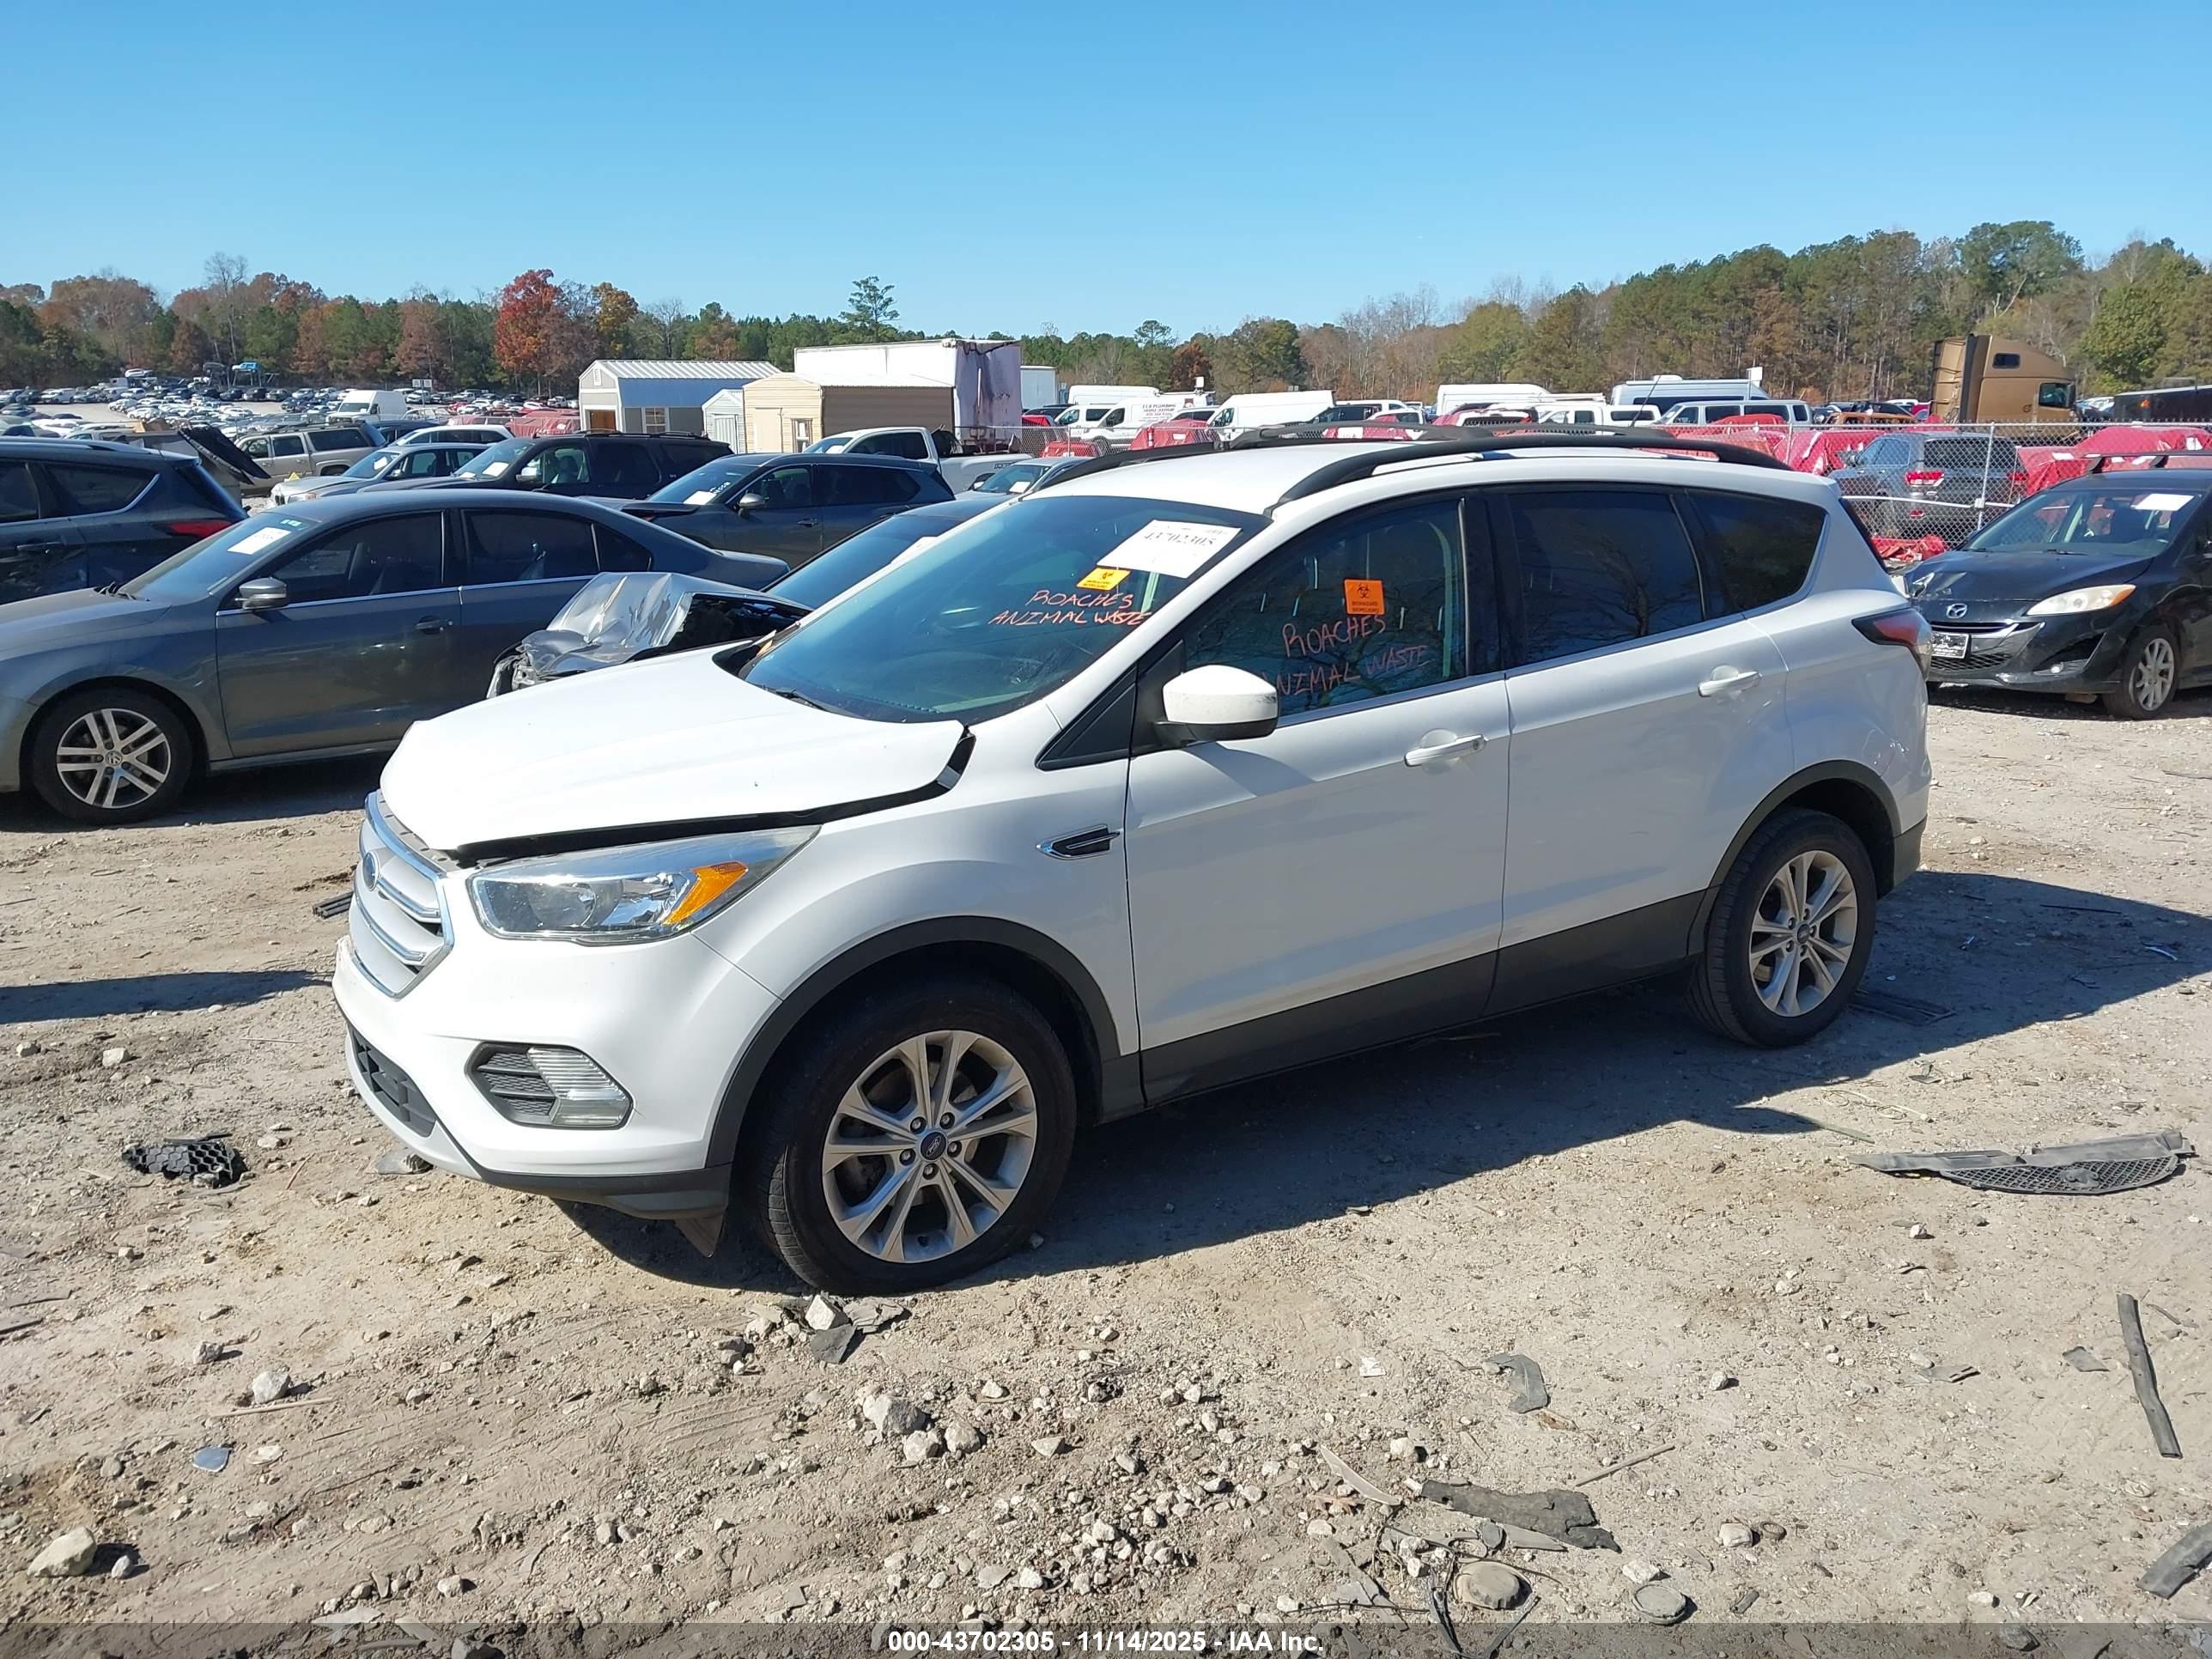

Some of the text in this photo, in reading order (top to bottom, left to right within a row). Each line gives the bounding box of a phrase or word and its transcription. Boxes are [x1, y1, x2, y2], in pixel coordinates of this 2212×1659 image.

[1025, 590, 1134, 609] ROACHES
[988, 610, 1152, 626] ANIMAL WASTE
[1282, 615, 1386, 658] ROACHES
[1261, 645, 1435, 696] NIMAL WASTE
